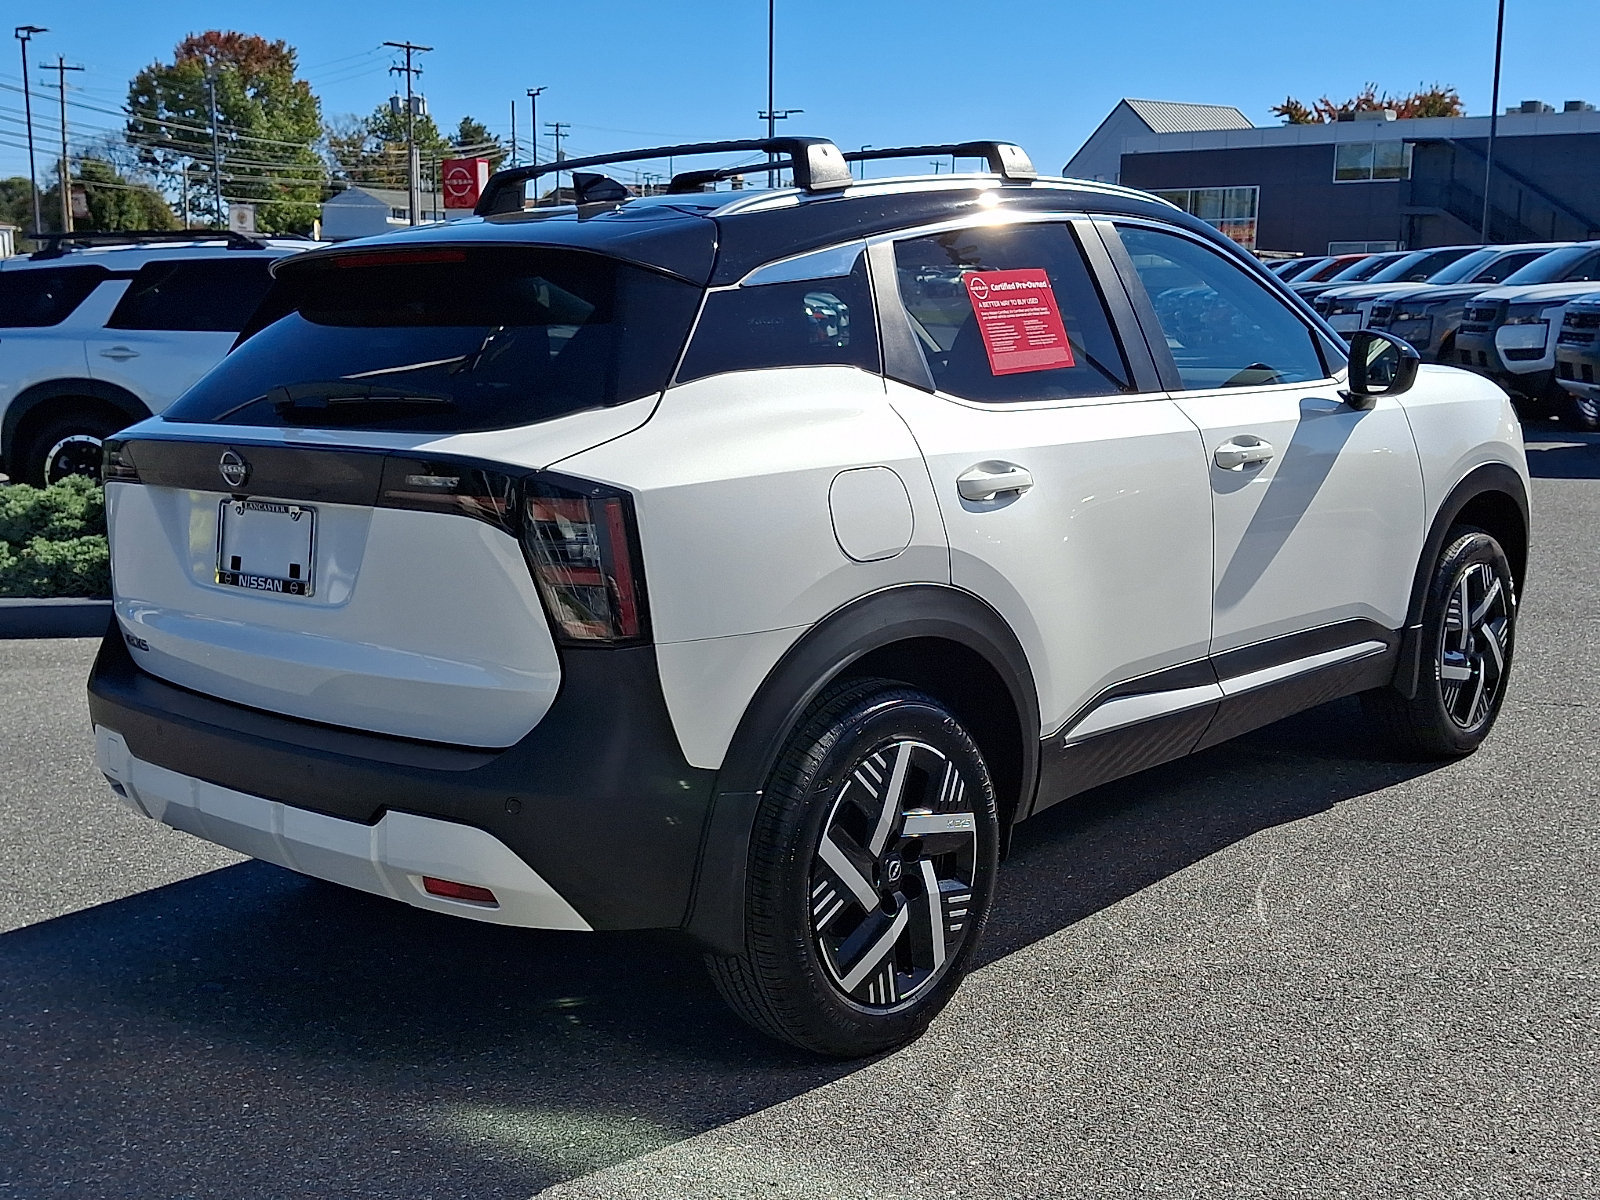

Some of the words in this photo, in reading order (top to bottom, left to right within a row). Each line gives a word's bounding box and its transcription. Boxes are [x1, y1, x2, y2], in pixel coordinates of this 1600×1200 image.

[990, 282, 1015, 291] Certified
[1016, 280, 1047, 289] Pre-Owned
[982, 300, 1000, 308] BETTER
[219, 464, 246, 474] SSAN
[244, 502, 286, 513] LANCASTER
[238, 574, 283, 592] NISSAN
